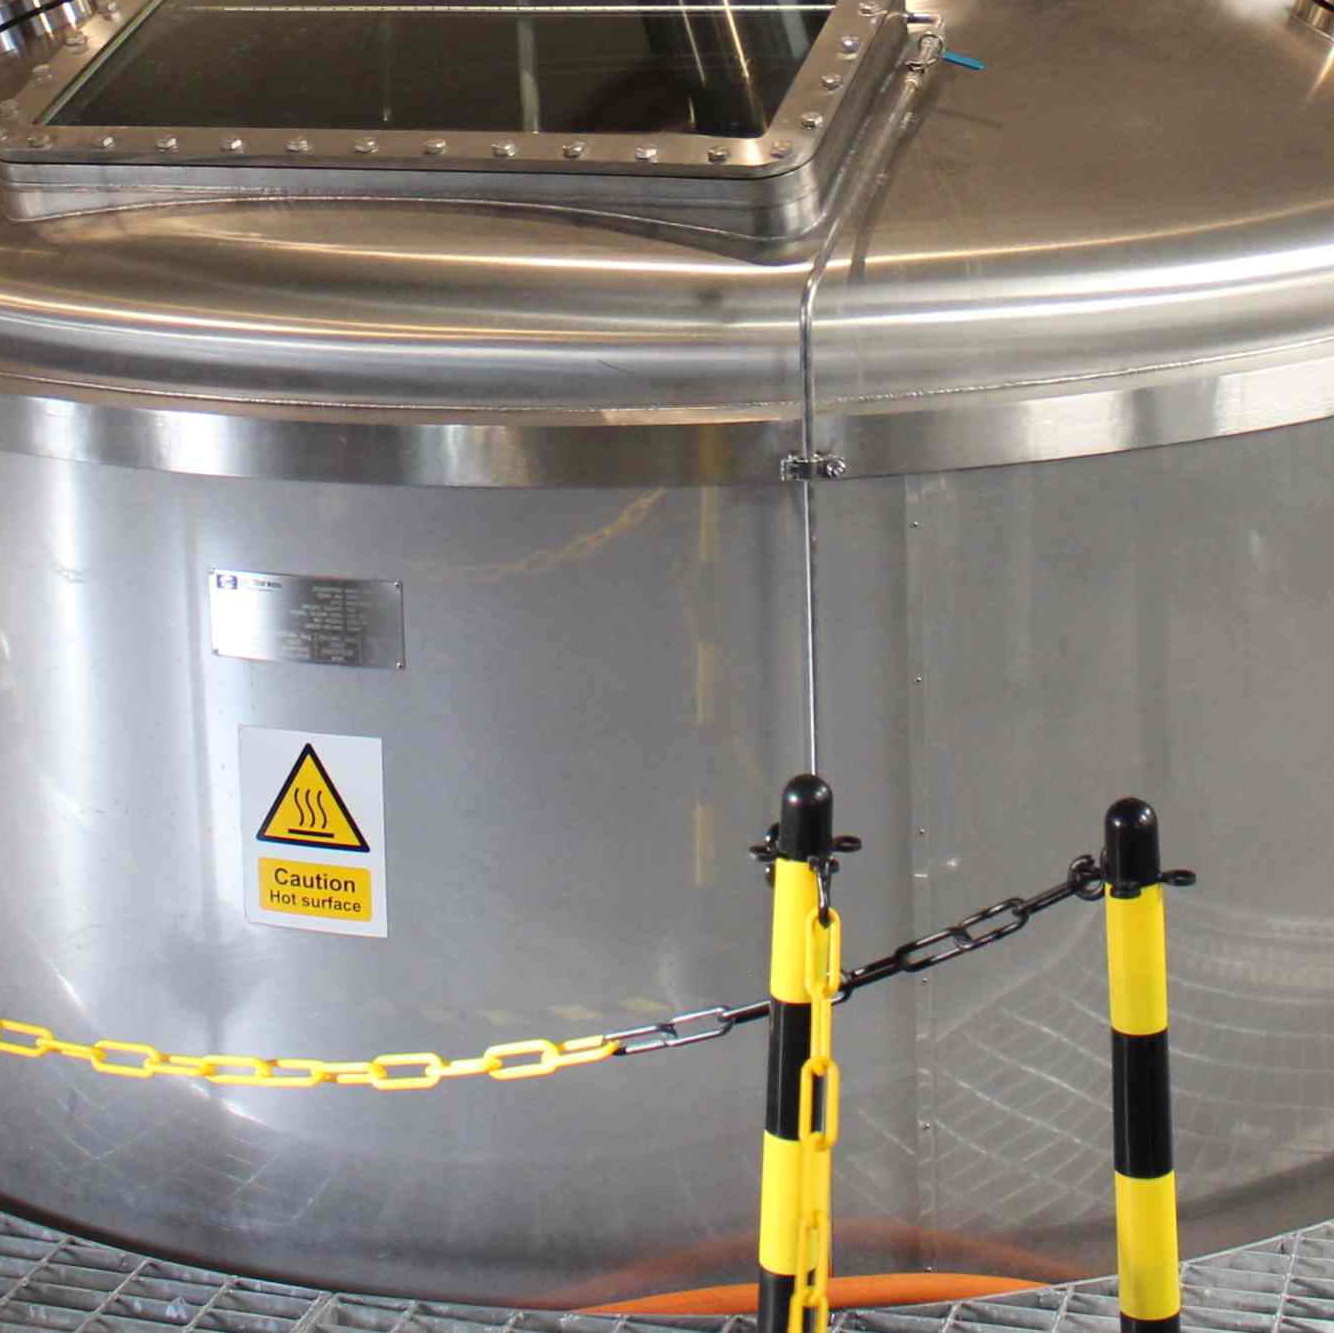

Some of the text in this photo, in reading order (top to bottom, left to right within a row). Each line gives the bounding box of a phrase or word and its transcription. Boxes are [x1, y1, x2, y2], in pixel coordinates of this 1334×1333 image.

[274, 867, 356, 894] Caution
[269, 889, 362, 913] Hot surface
